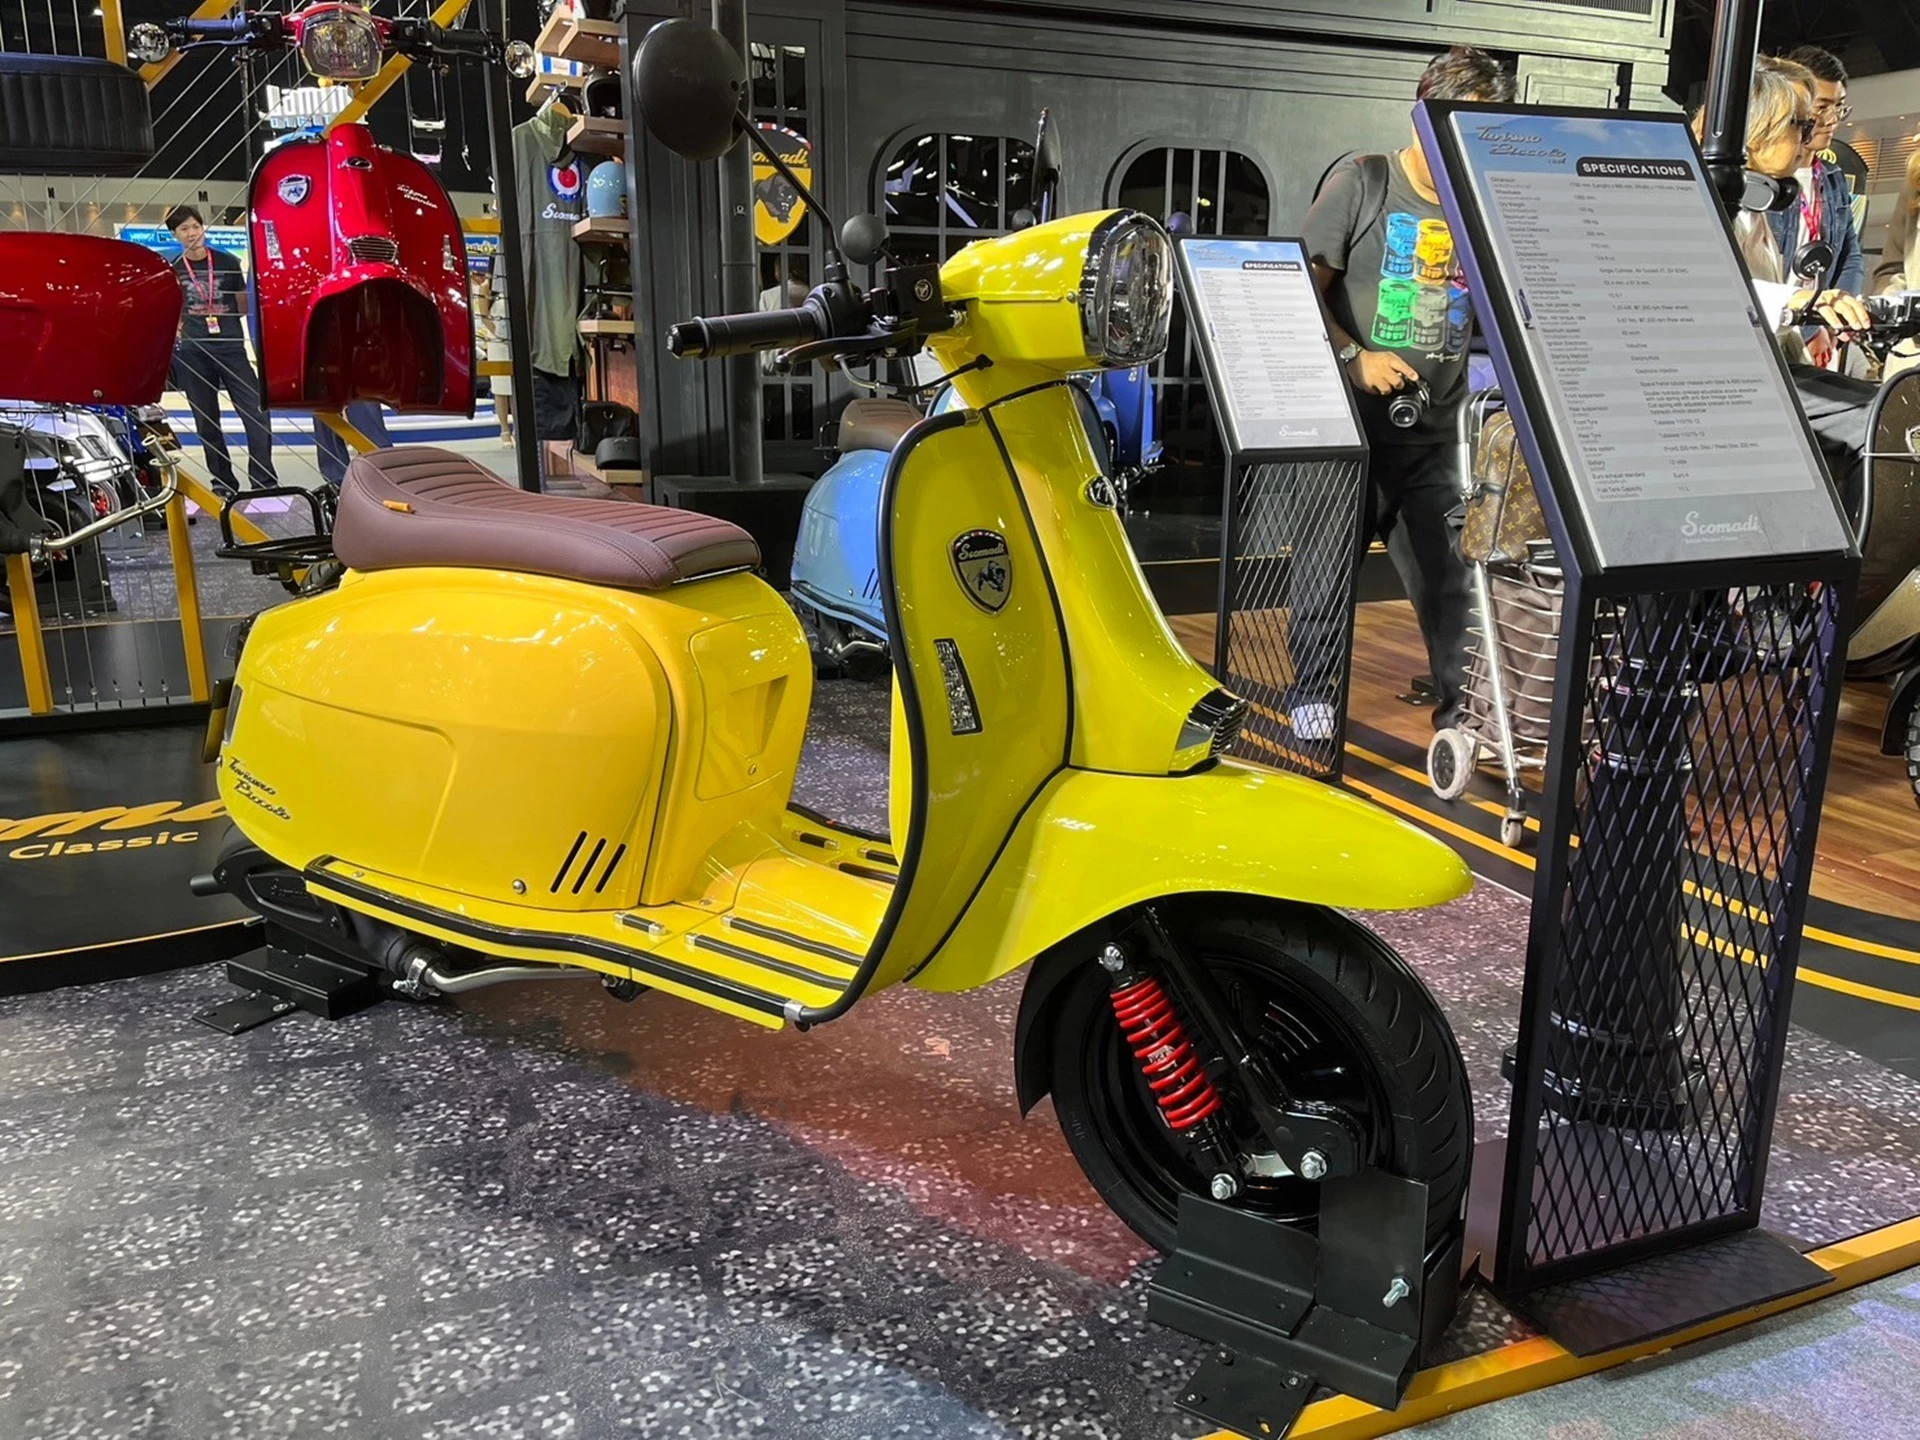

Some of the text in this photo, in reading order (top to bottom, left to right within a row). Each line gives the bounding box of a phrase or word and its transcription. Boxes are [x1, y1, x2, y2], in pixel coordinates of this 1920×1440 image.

[1475, 126, 1543, 144] Turismo
[1489, 143, 1567, 158] Piccolo
[1582, 162, 1686, 176] SPECIFICATIONS
[198, 191, 208, 202] M
[483, 203, 490, 214] K
[1244, 262, 1299, 270] SPECIFICATIONS
[1681, 511, 1761, 536] Scomadi
[228, 755, 277, 796] Turismo
[233, 777, 292, 820] Piccolo
[8, 831, 199, 860] Classic
